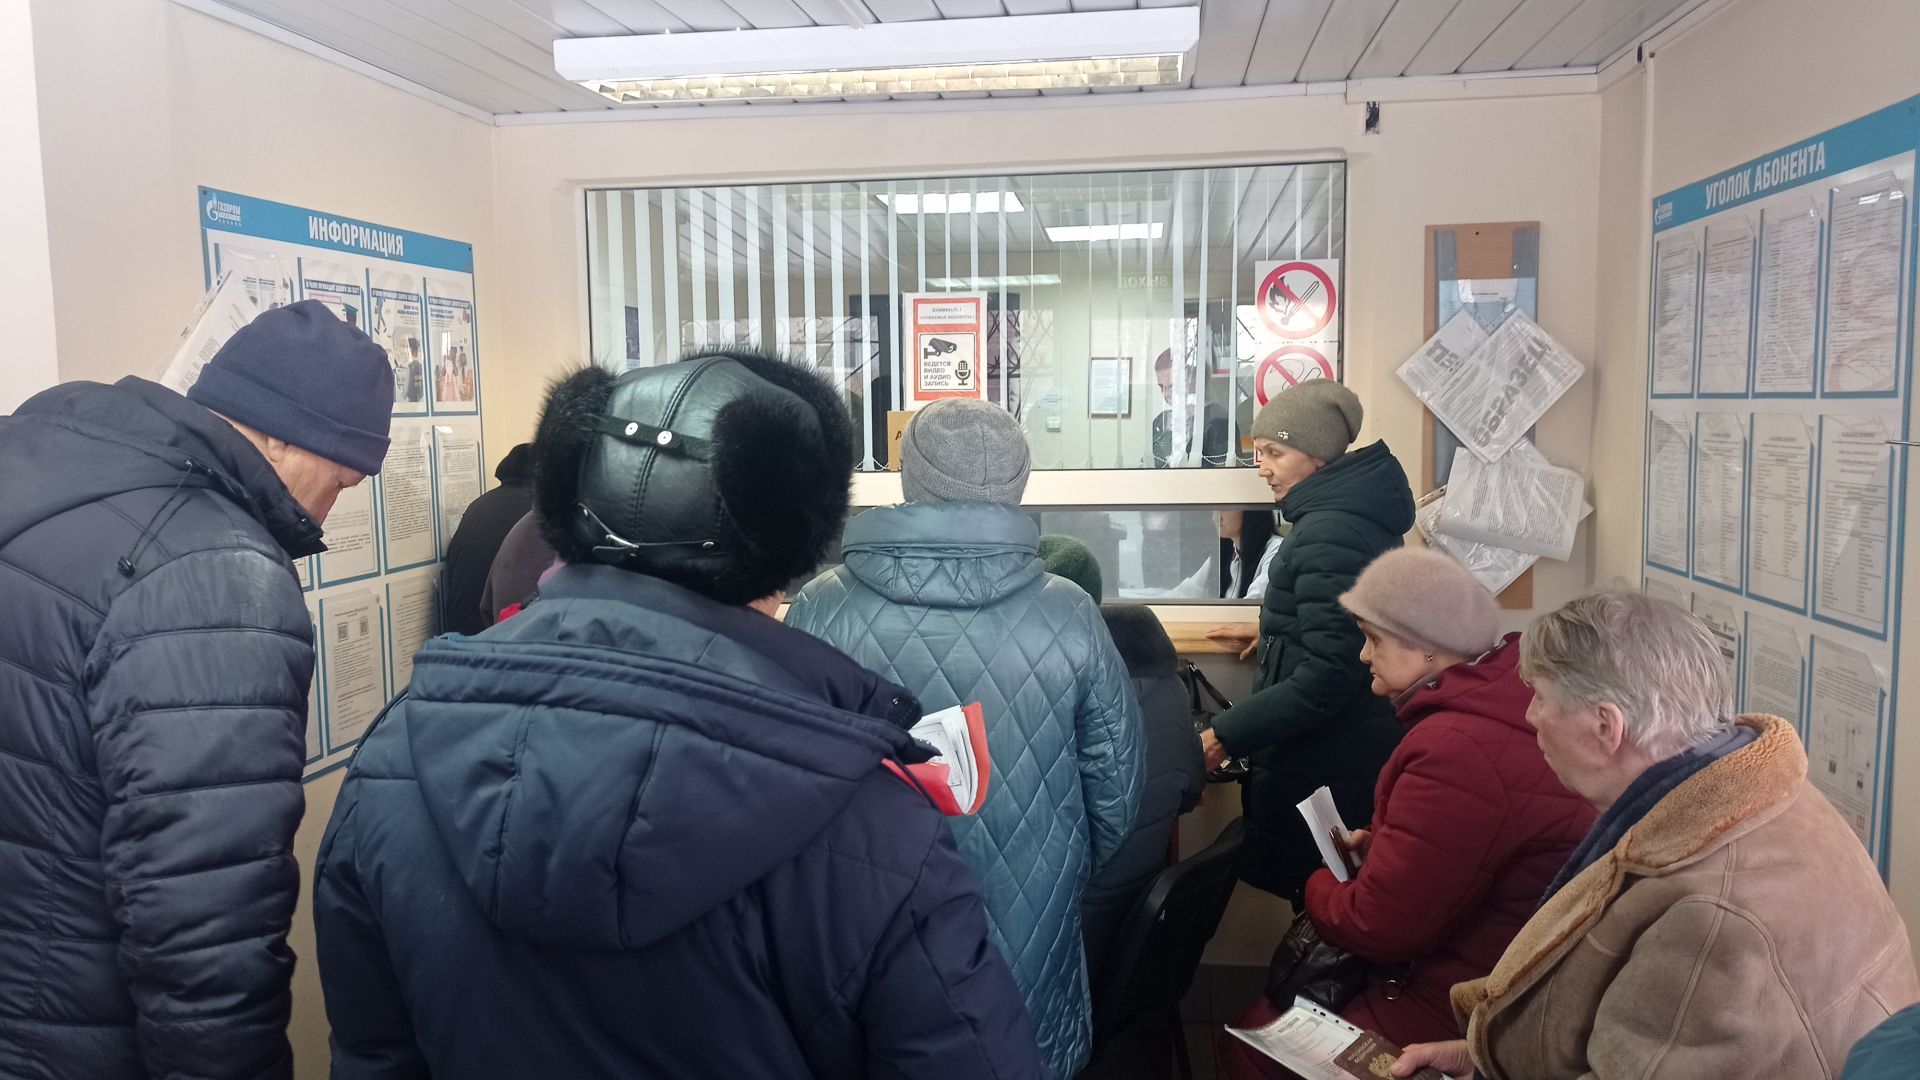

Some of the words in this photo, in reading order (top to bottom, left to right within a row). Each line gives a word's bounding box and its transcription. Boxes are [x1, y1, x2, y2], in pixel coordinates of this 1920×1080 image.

[1705, 168, 1752, 210] УГОЛОК
[1753, 141, 1826, 193] АБОНЕНТА
[308, 216, 404, 257] ИНФОРМАЦИЯ
[1472, 336, 1551, 448] ОБРАЗЕЦ
